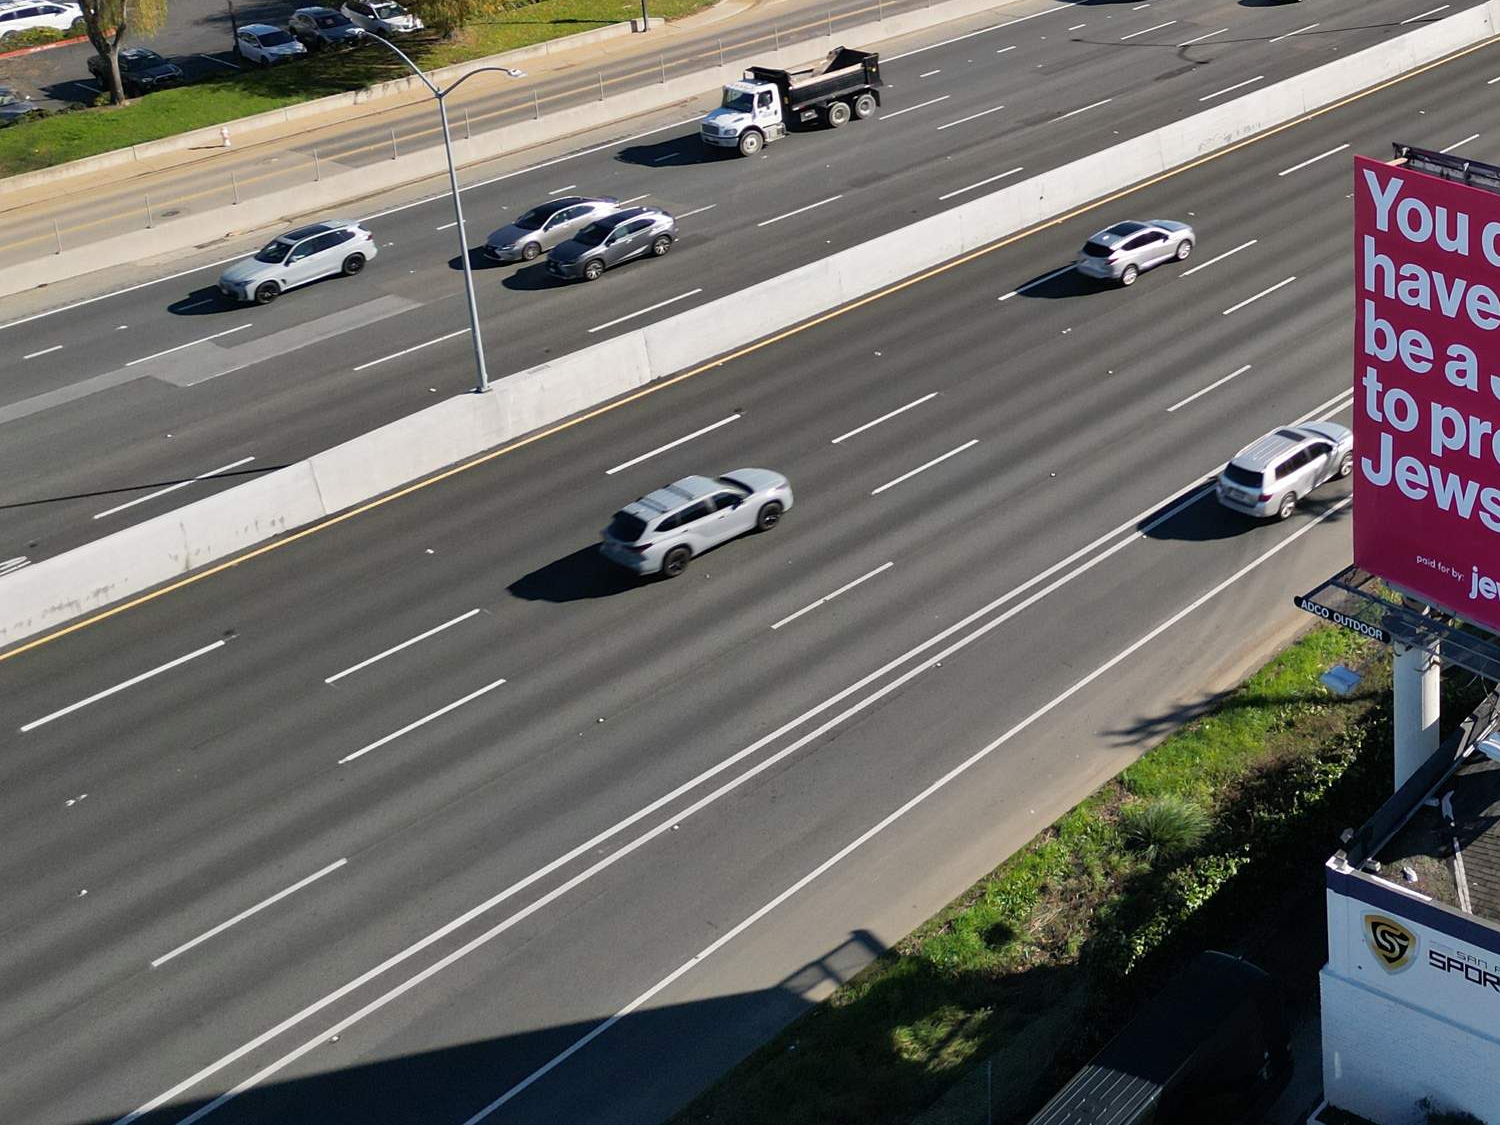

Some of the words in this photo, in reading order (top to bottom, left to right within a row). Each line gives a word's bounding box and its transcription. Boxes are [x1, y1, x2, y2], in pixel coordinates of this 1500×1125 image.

[1362, 169, 1469, 257] You
[1363, 298, 1434, 374] be
[1444, 342, 1479, 393] a
[1362, 367, 1419, 433] to
[1416, 555, 1436, 569] paid
[1437, 562, 1450, 574] for
[1451, 567, 1465, 582] by:
[1301, 599, 1330, 619] ADCO
[1333, 613, 1383, 641] OUTDOOR
[1456, 950, 1488, 970] SAN
